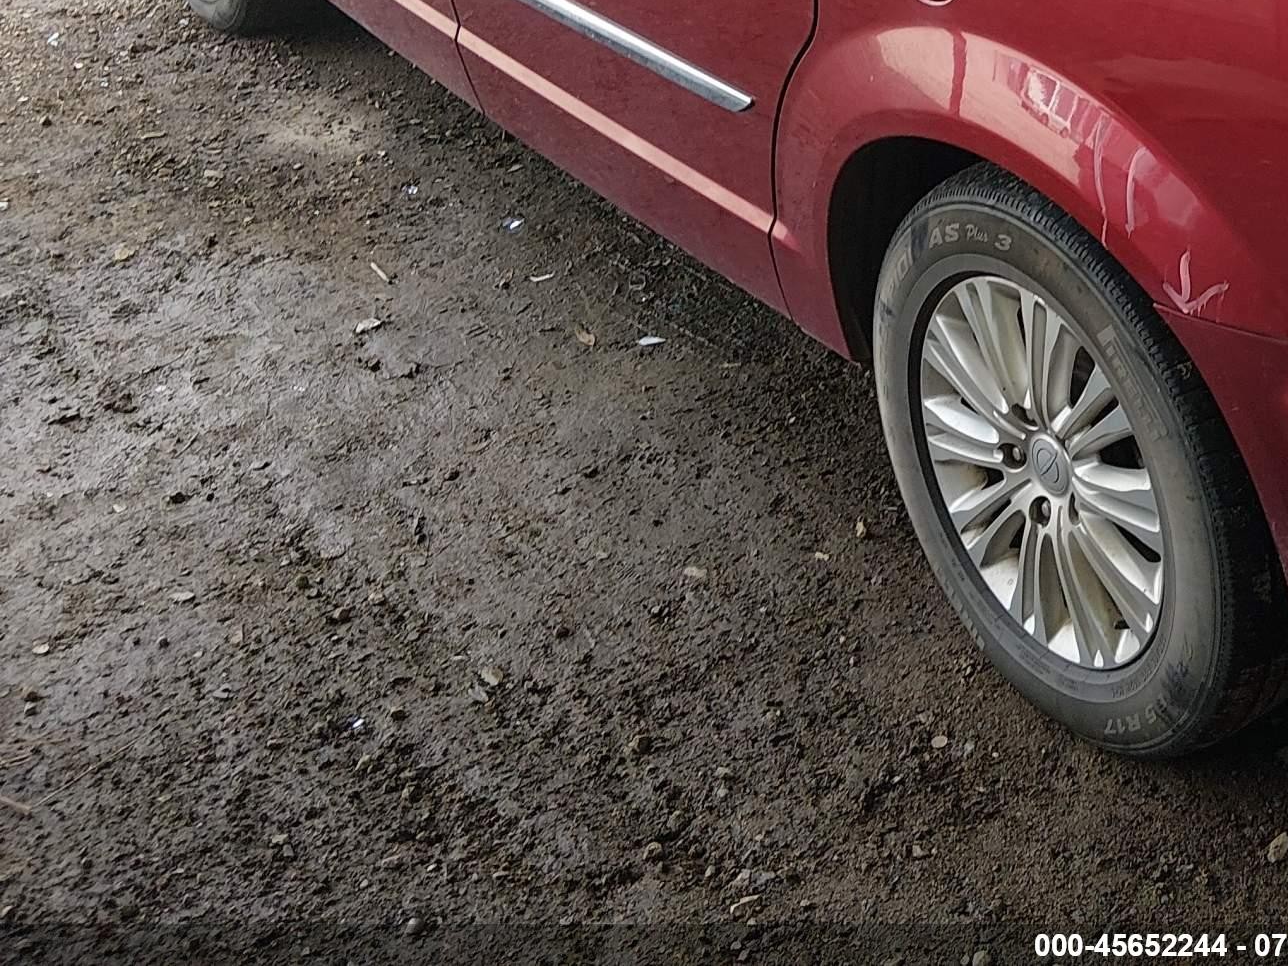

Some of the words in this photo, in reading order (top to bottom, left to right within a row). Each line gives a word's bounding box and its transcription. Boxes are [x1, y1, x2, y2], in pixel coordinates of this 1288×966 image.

[928, 223, 960, 249] AS
[965, 224, 989, 243] Plus
[994, 233, 1012, 252] 3
